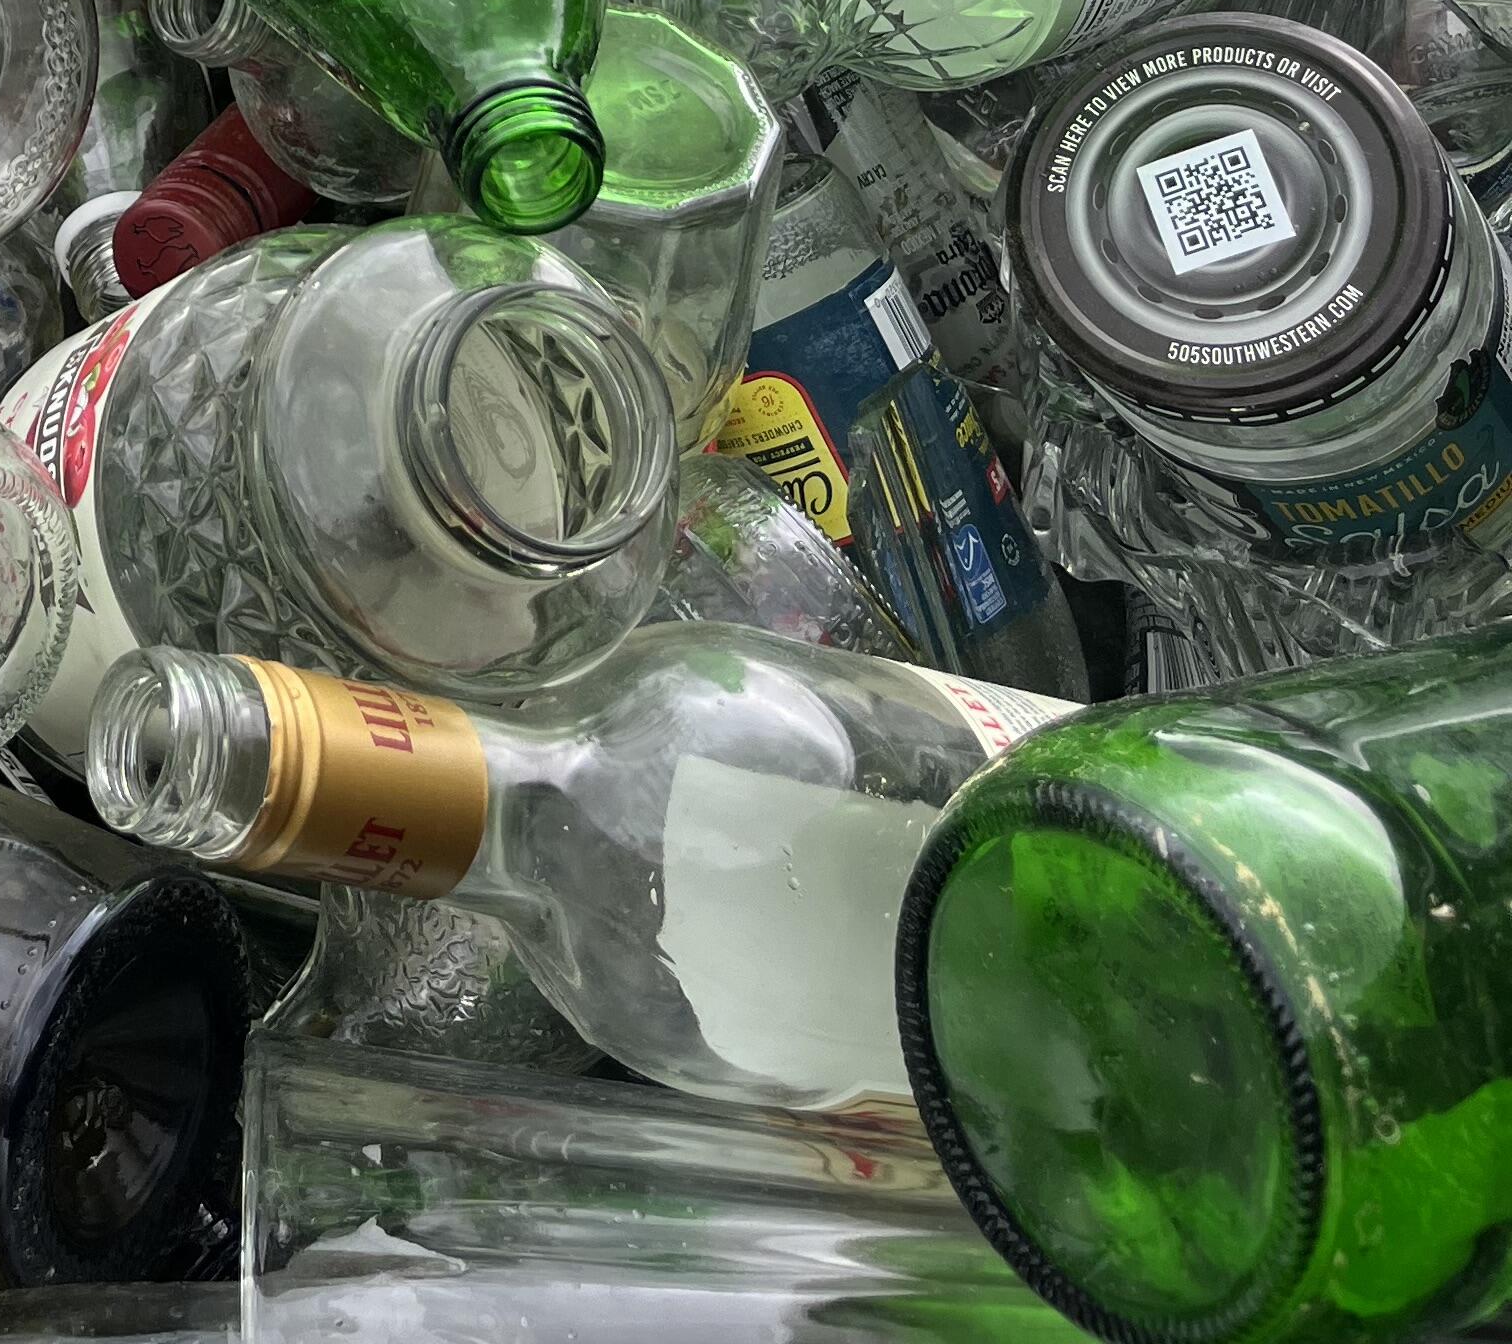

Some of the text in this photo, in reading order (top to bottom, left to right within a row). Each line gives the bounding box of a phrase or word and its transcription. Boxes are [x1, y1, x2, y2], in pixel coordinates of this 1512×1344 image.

[1046, 46, 1341, 193] SCAN HERE TO VIEW MORE PRODUCTS OR VISIT
[855, 162, 886, 188] CA CRV
[1167, 282, 1364, 365] 505SOUTHWESTERN.COM
[759, 392, 775, 408] 16
[751, 419, 802, 442] CHOWDERS
[769, 442, 805, 456] PERFECT
[1271, 442, 1465, 522] TOMATILLO
[1343, 473, 1380, 488] NEW
[1383, 438, 1437, 475] MEXICO
